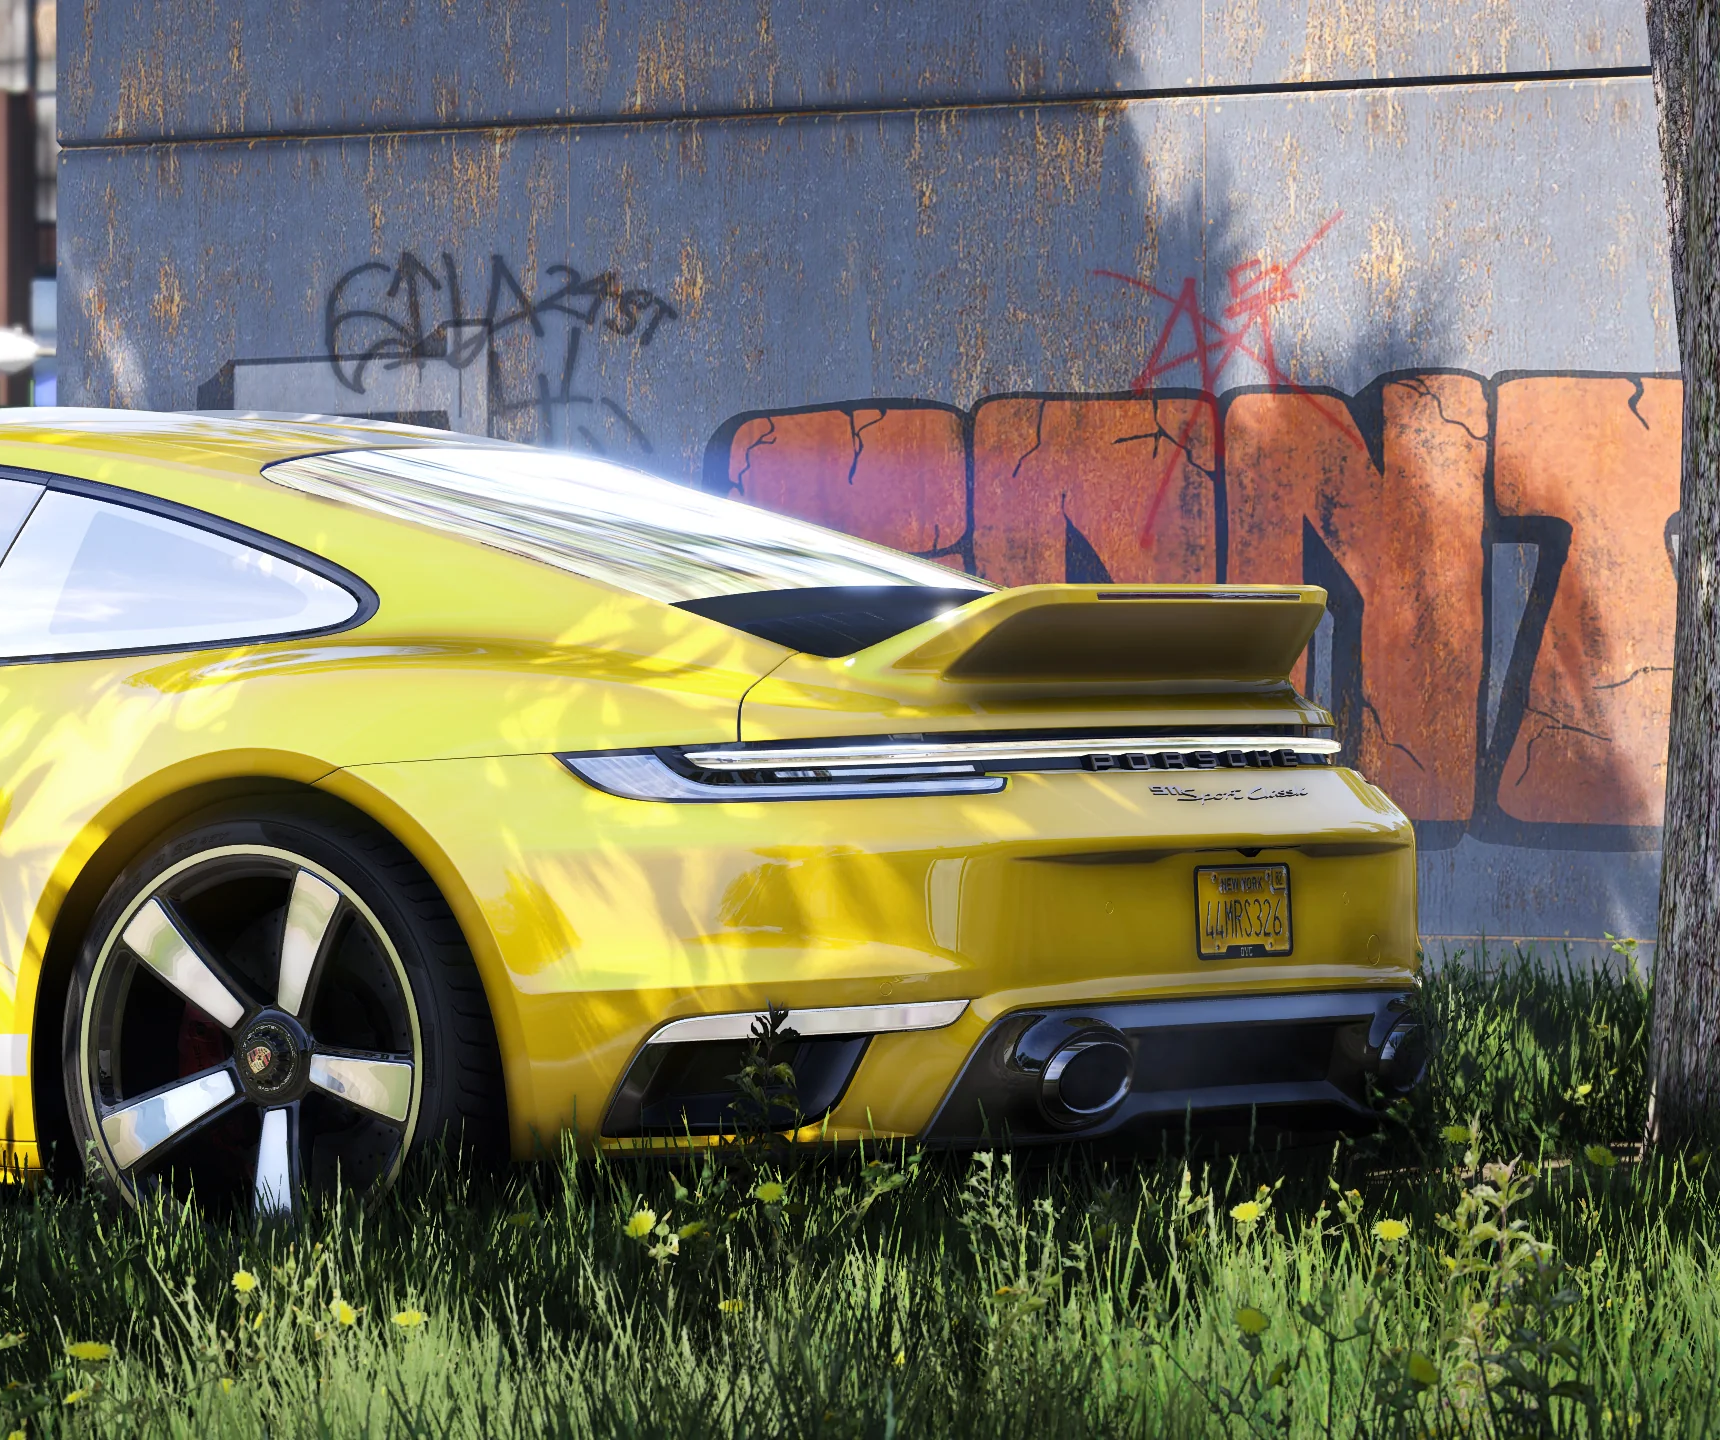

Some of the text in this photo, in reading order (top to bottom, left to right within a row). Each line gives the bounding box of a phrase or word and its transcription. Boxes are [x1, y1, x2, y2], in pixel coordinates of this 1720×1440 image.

[1084, 749, 1298, 771] PORSCHE
[1177, 787, 1243, 805] Sport
[1219, 876, 1263, 893] NEW YORK
[1205, 898, 1283, 940] 44MRS326
